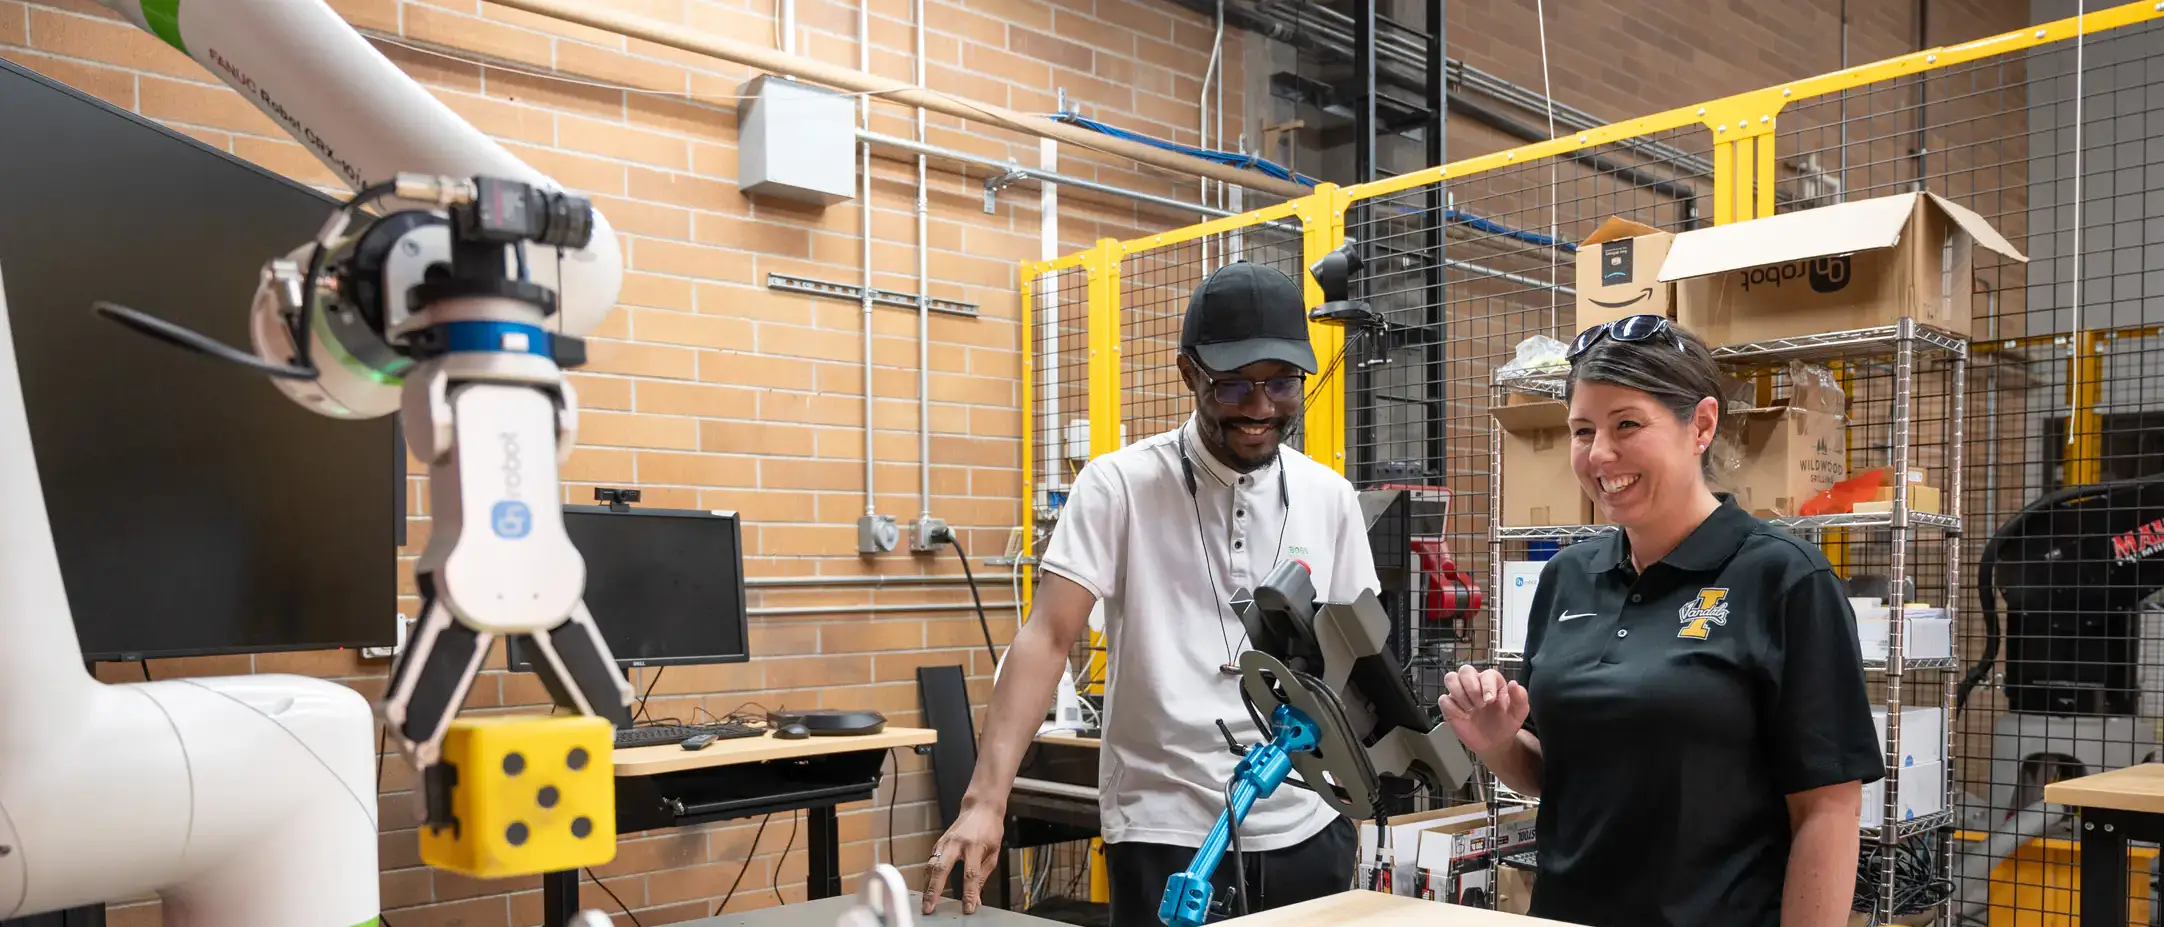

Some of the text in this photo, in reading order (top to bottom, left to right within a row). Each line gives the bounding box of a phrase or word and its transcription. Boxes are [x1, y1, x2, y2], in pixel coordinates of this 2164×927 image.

[209, 48, 257, 93] FANUC
[260, 88, 301, 132] Robot
[1741, 260, 1806, 291] robot
[1799, 459, 1843, 476] WILDWOOD
[1679, 601, 1729, 626] Vandals
